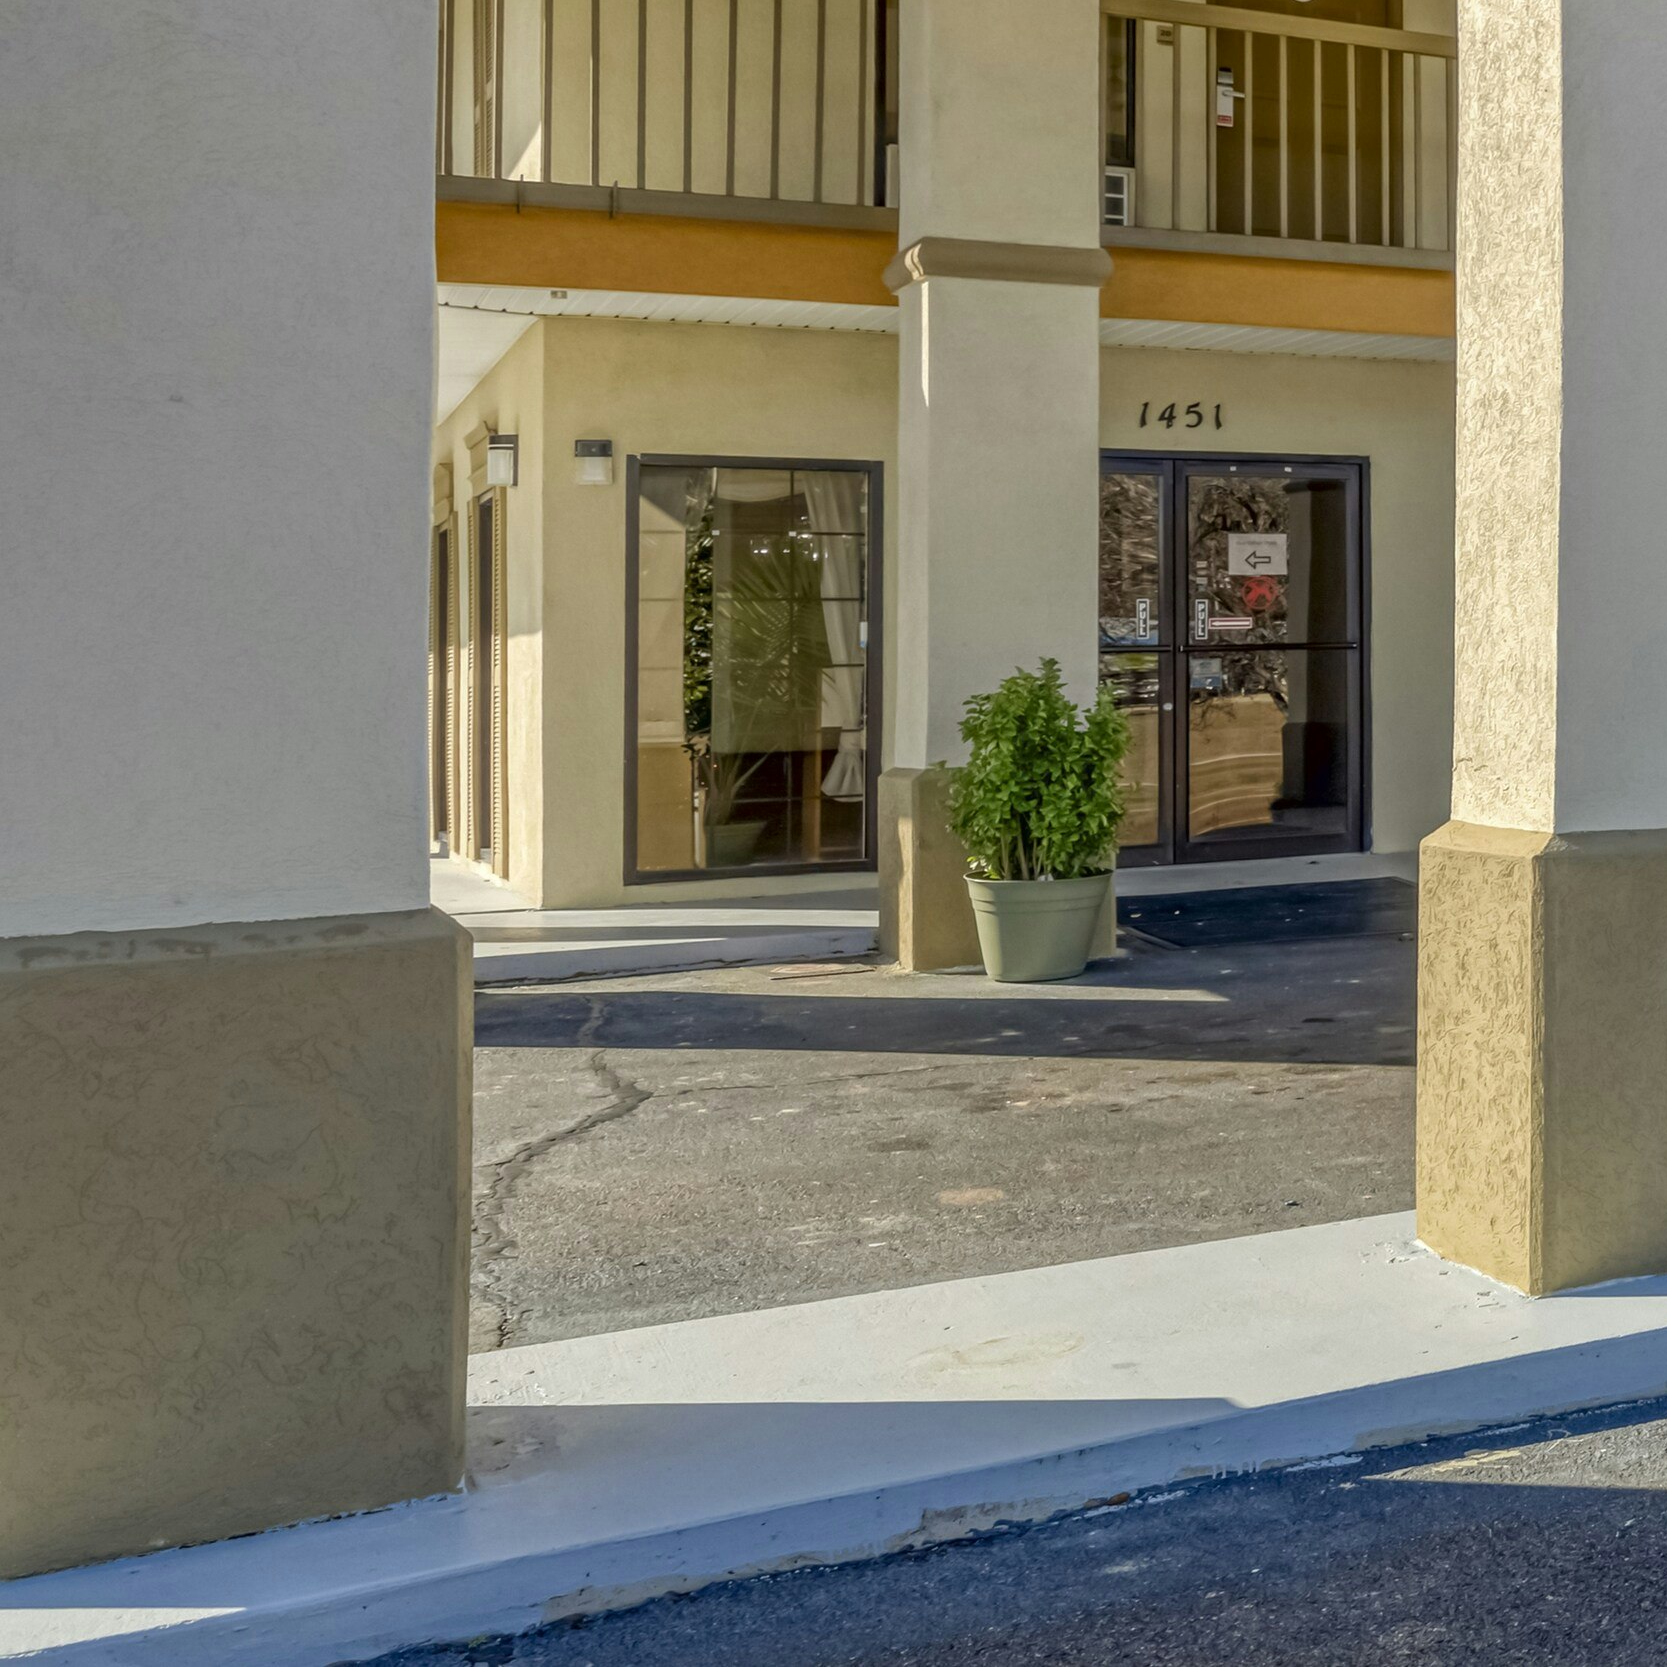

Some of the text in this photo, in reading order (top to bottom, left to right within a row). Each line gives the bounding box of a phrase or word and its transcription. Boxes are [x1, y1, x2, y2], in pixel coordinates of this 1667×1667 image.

[1139, 401, 1222, 430] 1451
[1138, 601, 1148, 637] PULL
[1197, 601, 1206, 637] PULL
